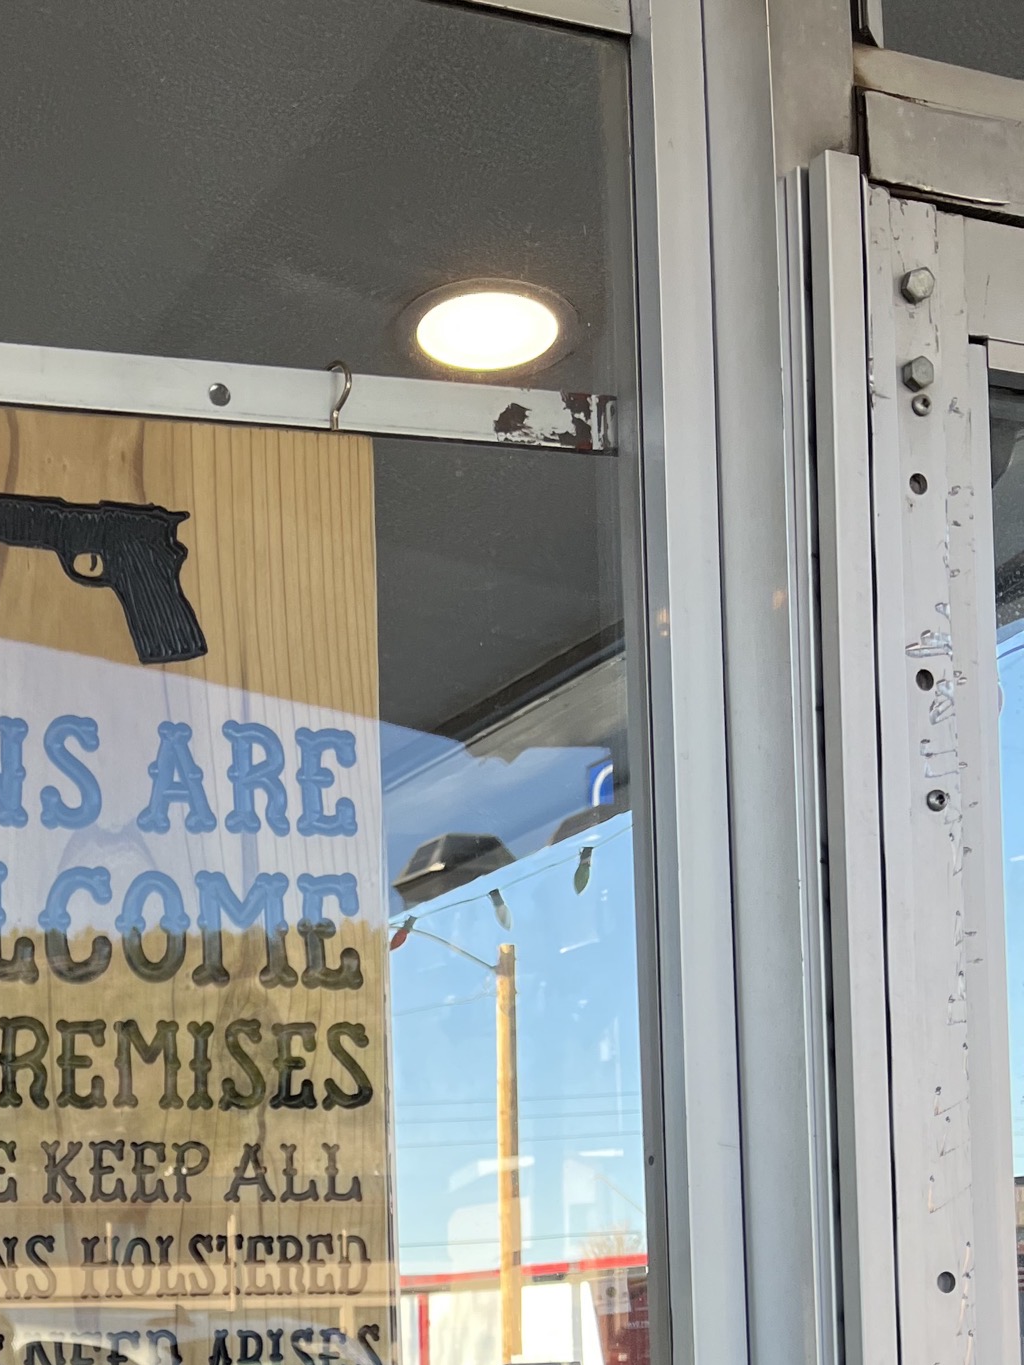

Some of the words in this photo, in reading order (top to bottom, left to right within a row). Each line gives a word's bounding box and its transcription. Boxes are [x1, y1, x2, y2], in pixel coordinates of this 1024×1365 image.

[137, 720, 359, 837] ARE
[41, 1139, 211, 1203] KEEP
[225, 1142, 364, 1203] ALL
[80, 1233, 371, 1299] HOLSTERED
